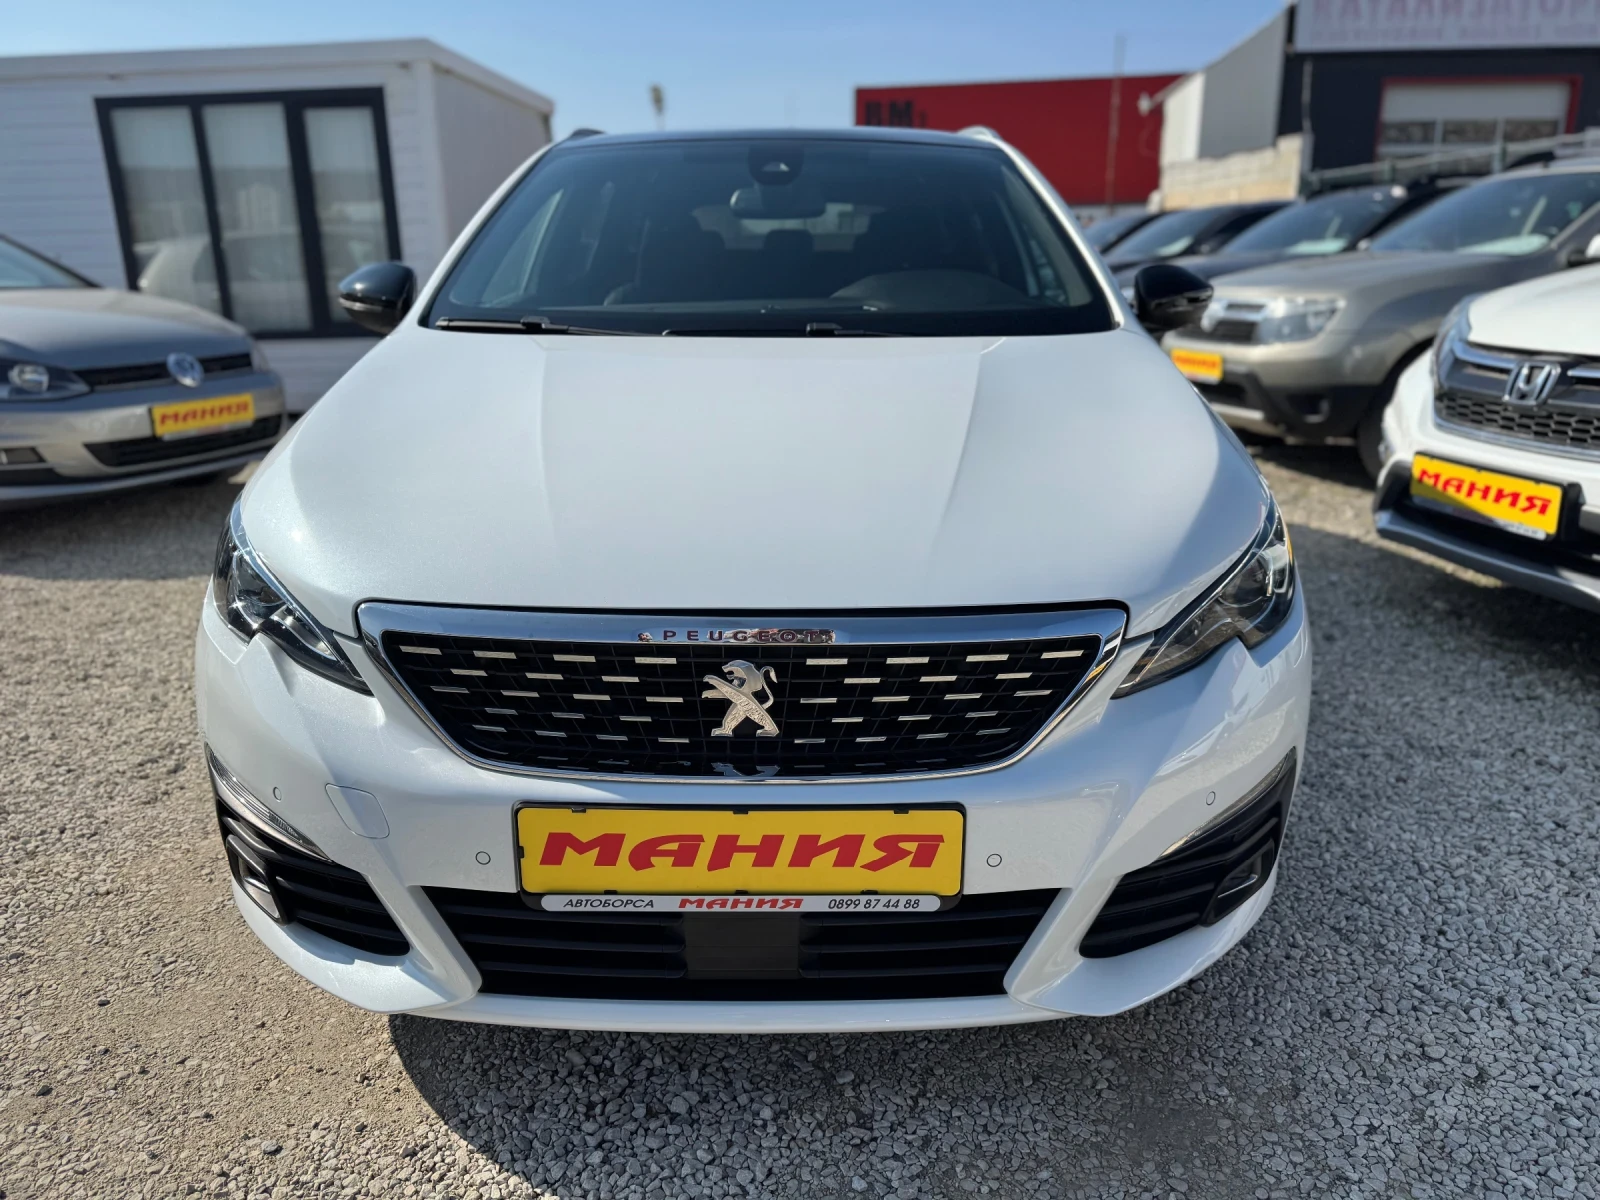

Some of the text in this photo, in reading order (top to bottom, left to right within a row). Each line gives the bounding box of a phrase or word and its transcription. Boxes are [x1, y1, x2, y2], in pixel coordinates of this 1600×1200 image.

[1418, 468, 1552, 516] МАНИЯ
[662, 629, 820, 642] PEUGEOT
[539, 832, 945, 872] МАНИЯ
[562, 897, 921, 910] АВТОБОРСА МАНИЯ 0899 87 44 88
